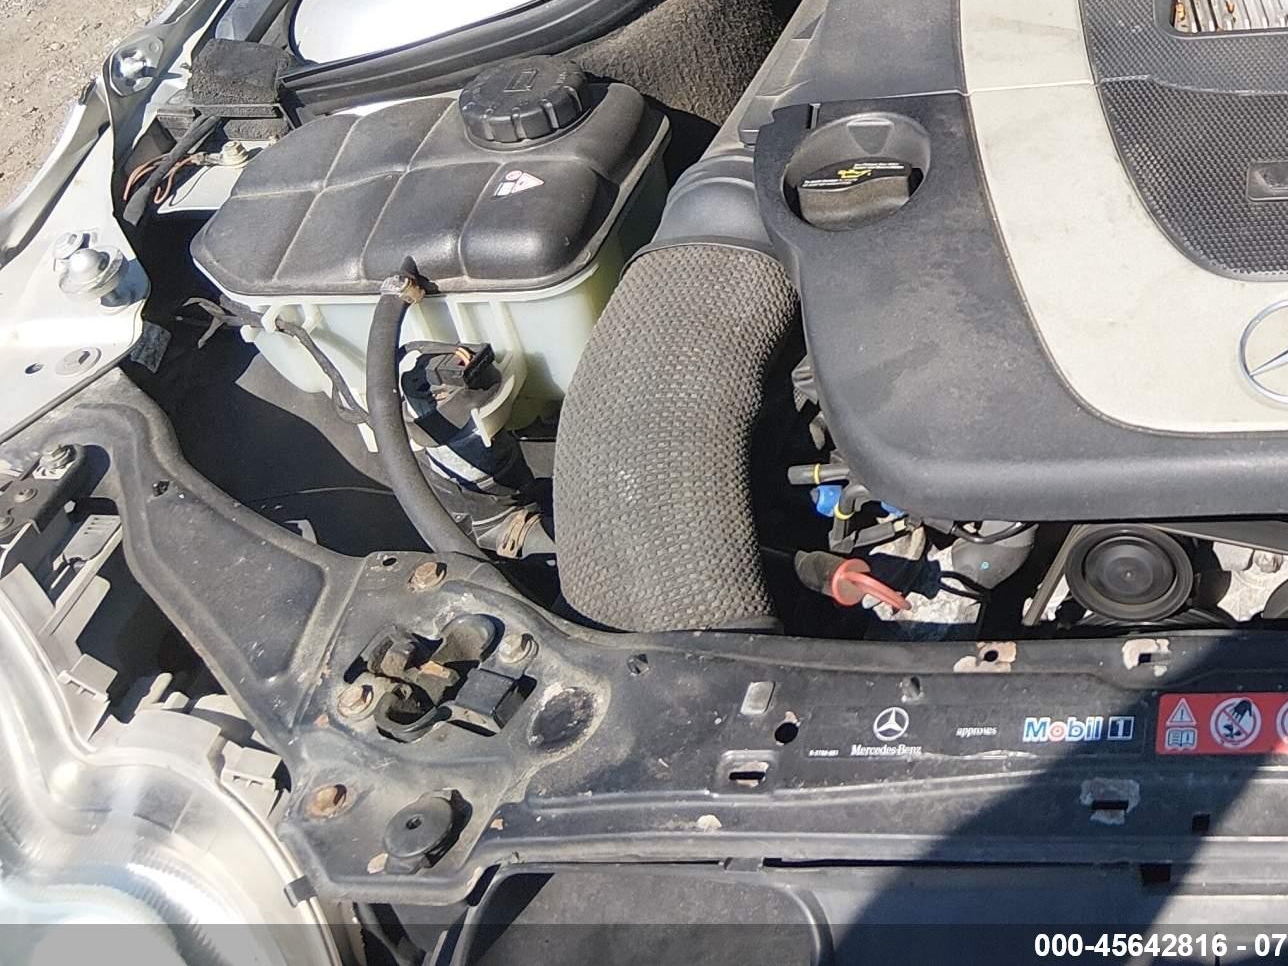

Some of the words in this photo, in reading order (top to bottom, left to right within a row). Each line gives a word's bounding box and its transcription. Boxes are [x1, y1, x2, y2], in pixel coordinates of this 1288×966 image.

[956, 726, 997, 738] approves
[1023, 715, 1104, 743] Mobil
[850, 744, 922, 756] Mercedes-Benz
